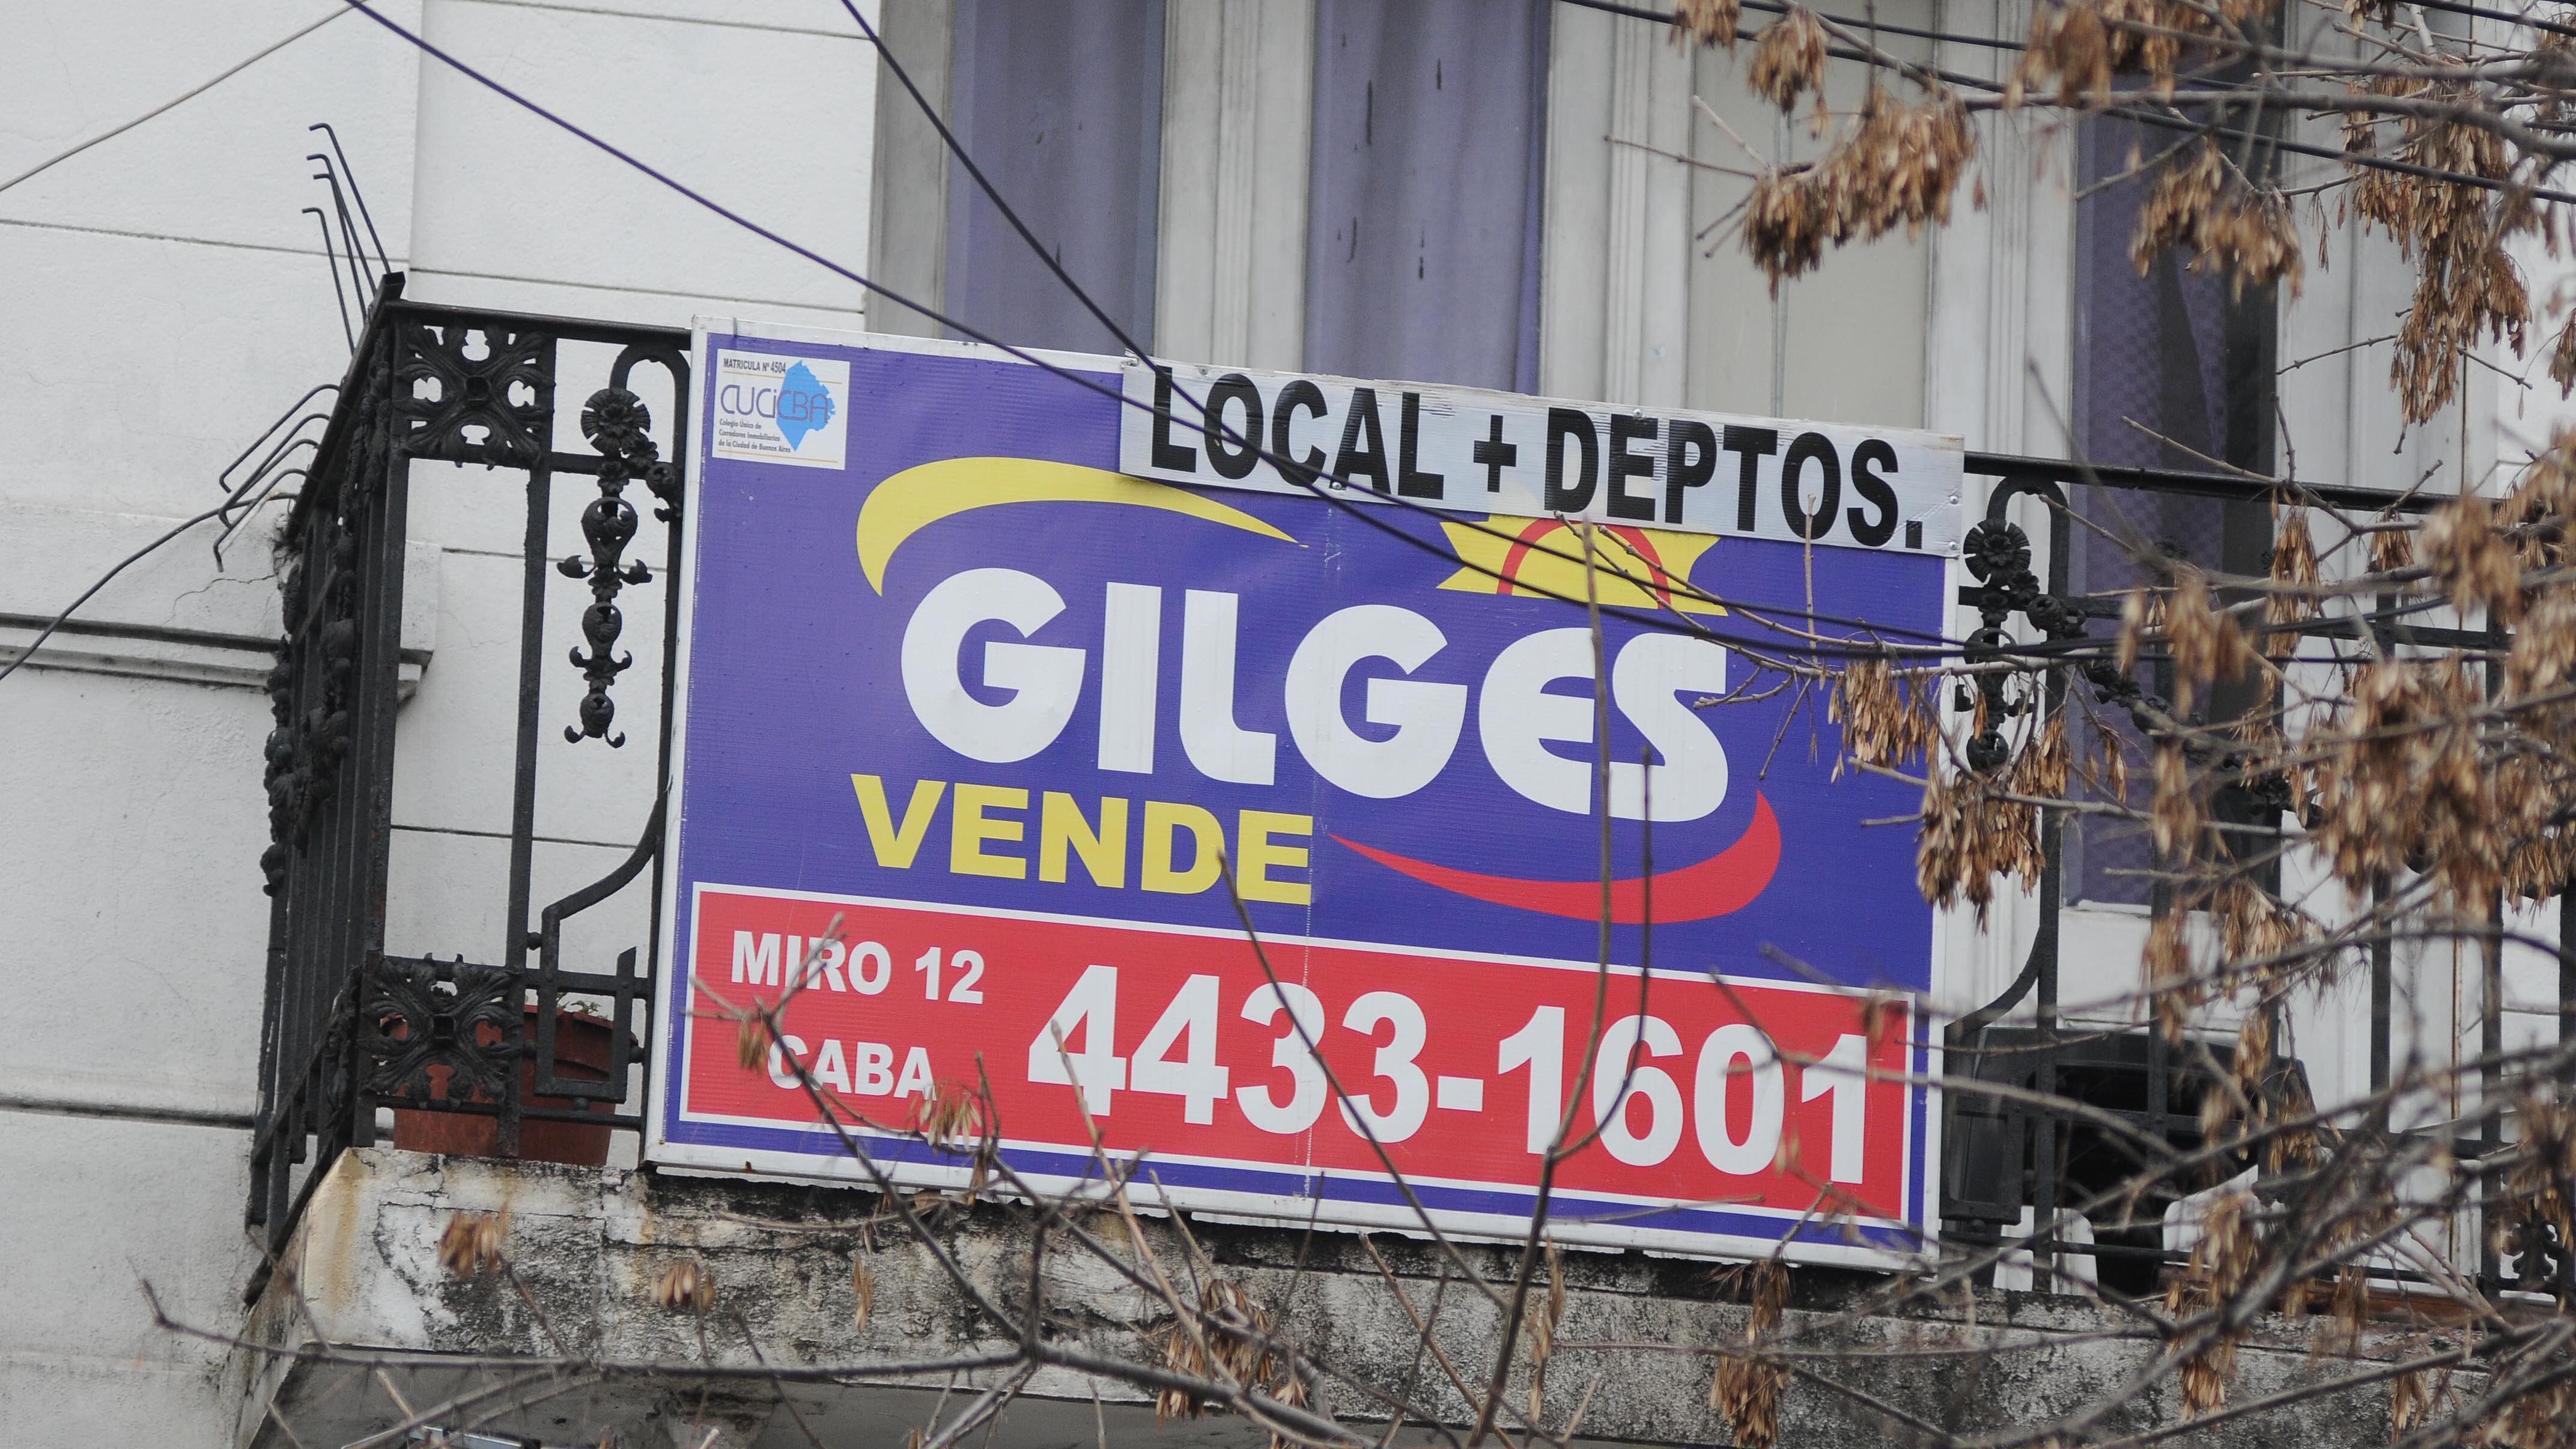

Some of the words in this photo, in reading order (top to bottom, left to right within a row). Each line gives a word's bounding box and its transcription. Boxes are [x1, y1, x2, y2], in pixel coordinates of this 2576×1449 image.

[723, 358, 761, 371] MATRICULA
[771, 361, 786, 374] 4504
[718, 429, 746, 438] Corredores
[747, 432, 780, 442] Inmobiliarios
[719, 419, 739, 428] Colegio
[732, 440, 750, 449] Ciudad
[1150, 365, 1444, 500] LOCAL
[1473, 414, 1517, 494] +
[1545, 407, 1922, 549] DEPTOS.
[901, 568, 1729, 822] GILGES
[850, 773, 1313, 906] VENDE
[731, 931, 892, 995] MIRO
[915, 946, 985, 1004] 12
[767, 1035, 937, 1101] CABA
[1027, 964, 1867, 1185] 4433-1601
